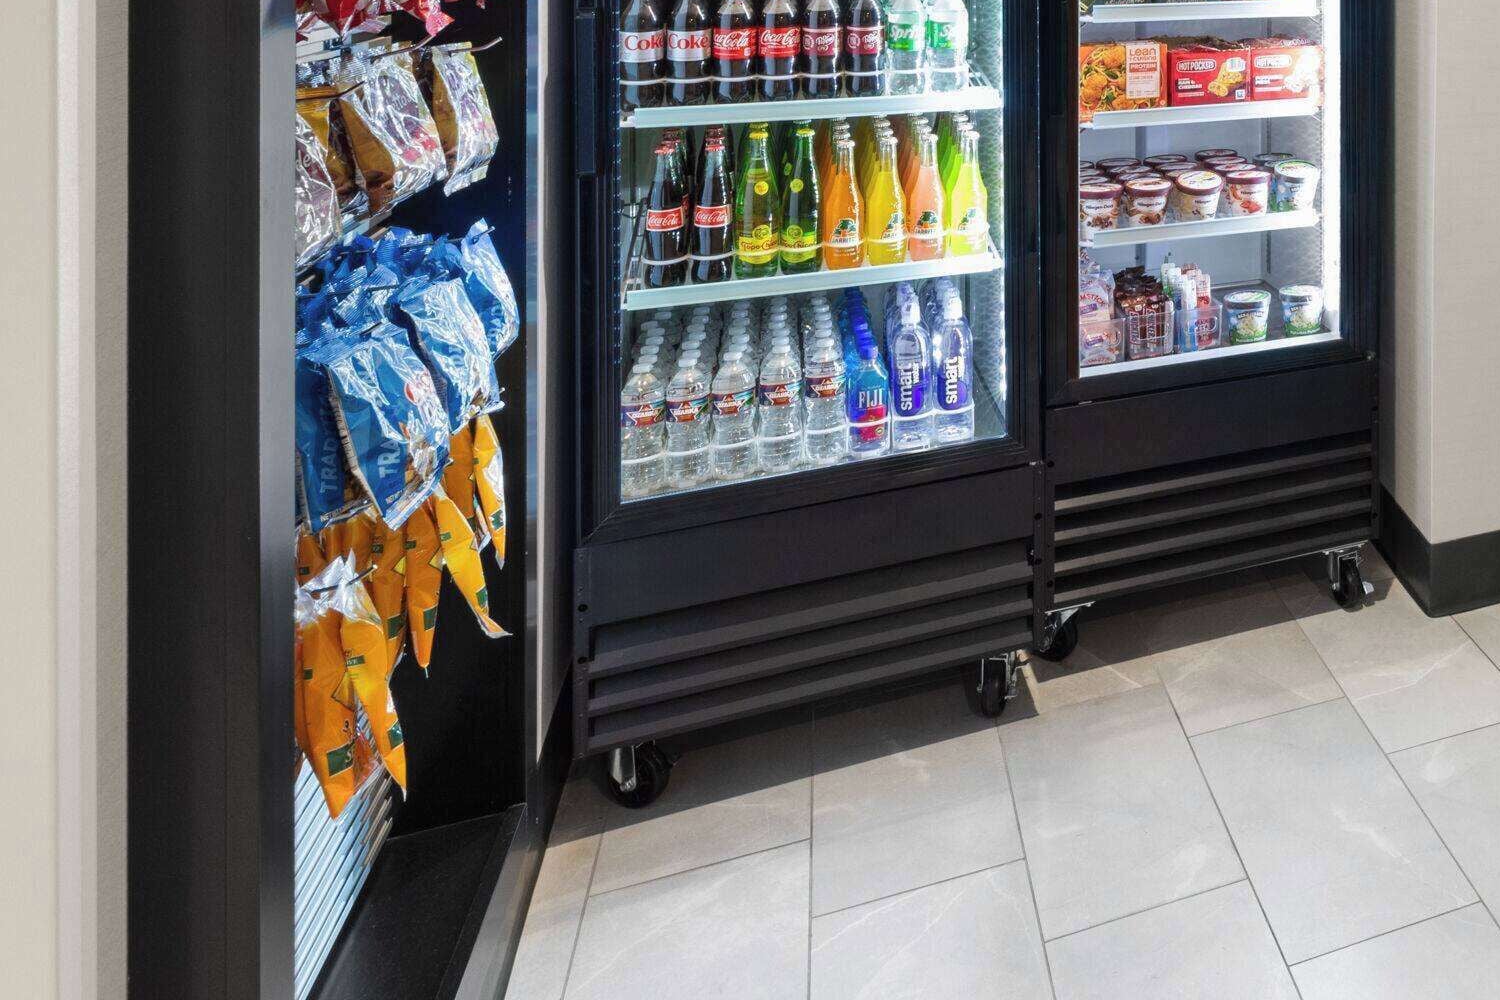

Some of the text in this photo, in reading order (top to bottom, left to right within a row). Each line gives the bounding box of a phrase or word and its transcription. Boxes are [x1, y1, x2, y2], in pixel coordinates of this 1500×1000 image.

[624, 33, 665, 51] Coke
[668, 32, 711, 50] Coke
[897, 363, 913, 411] smart
[944, 356, 958, 404] smart
[858, 389, 884, 408] FIJI
